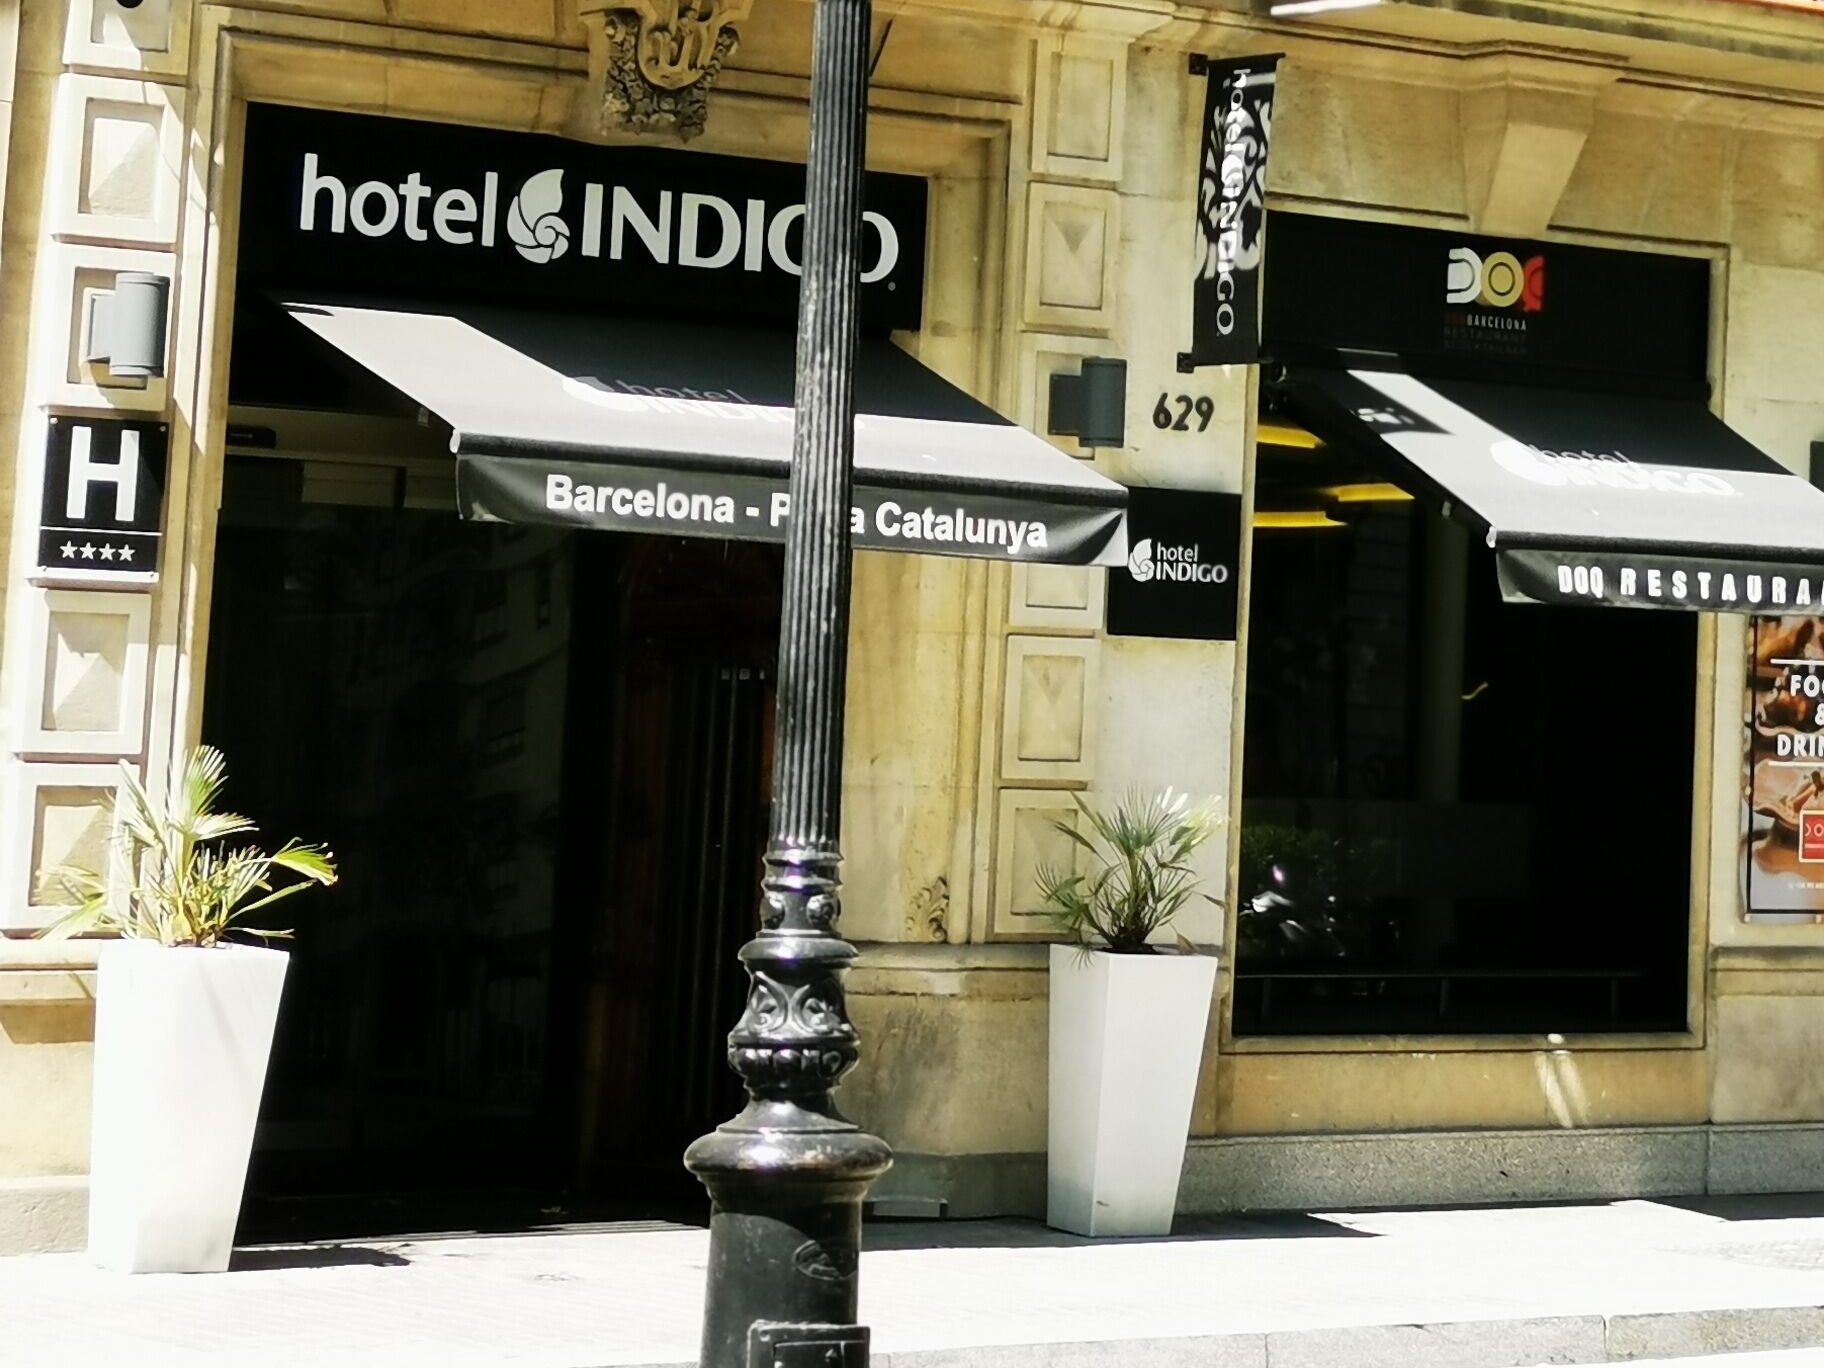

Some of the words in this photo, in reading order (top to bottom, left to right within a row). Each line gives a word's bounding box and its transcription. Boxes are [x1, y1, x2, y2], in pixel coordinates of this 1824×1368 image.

[300, 152, 498, 247] hotel
[1467, 314, 1527, 331] BARCELONA
[1153, 392, 1214, 432] 629
[66, 425, 140, 521] H
[546, 474, 734, 523] Barcelona
[875, 501, 1048, 554] Catalunya
[1157, 541, 1198, 562] hotel
[1156, 561, 1228, 583] INDIGO
[1557, 565, 1603, 599] DOQ
